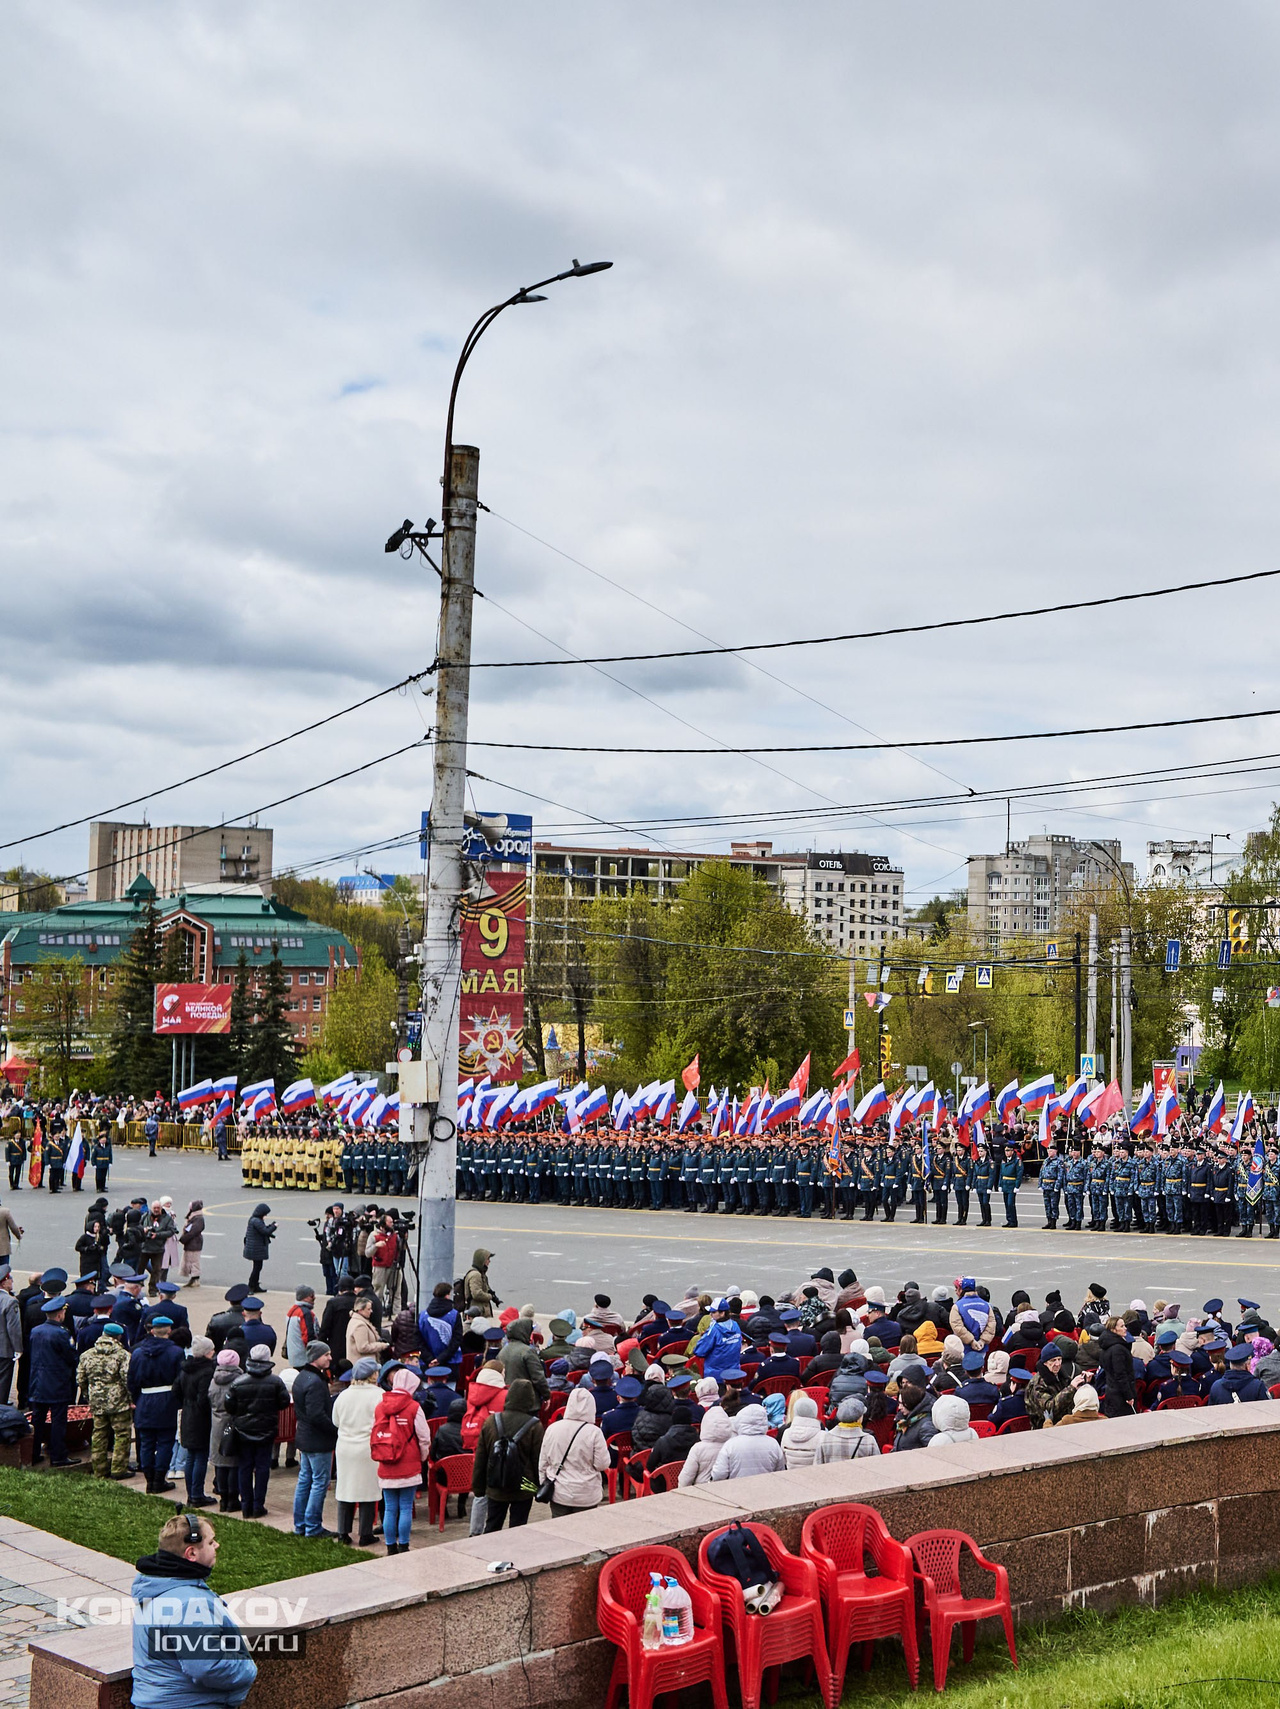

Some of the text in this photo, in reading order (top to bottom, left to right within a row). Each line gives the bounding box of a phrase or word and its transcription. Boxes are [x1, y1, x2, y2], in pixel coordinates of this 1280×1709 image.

[493, 838, 531, 857] ород
[819, 860, 843, 869] ОТЕЛЬ
[479, 907, 509, 958] 9
[185, 1003, 223, 1012] ВЕЛИКОЙ
